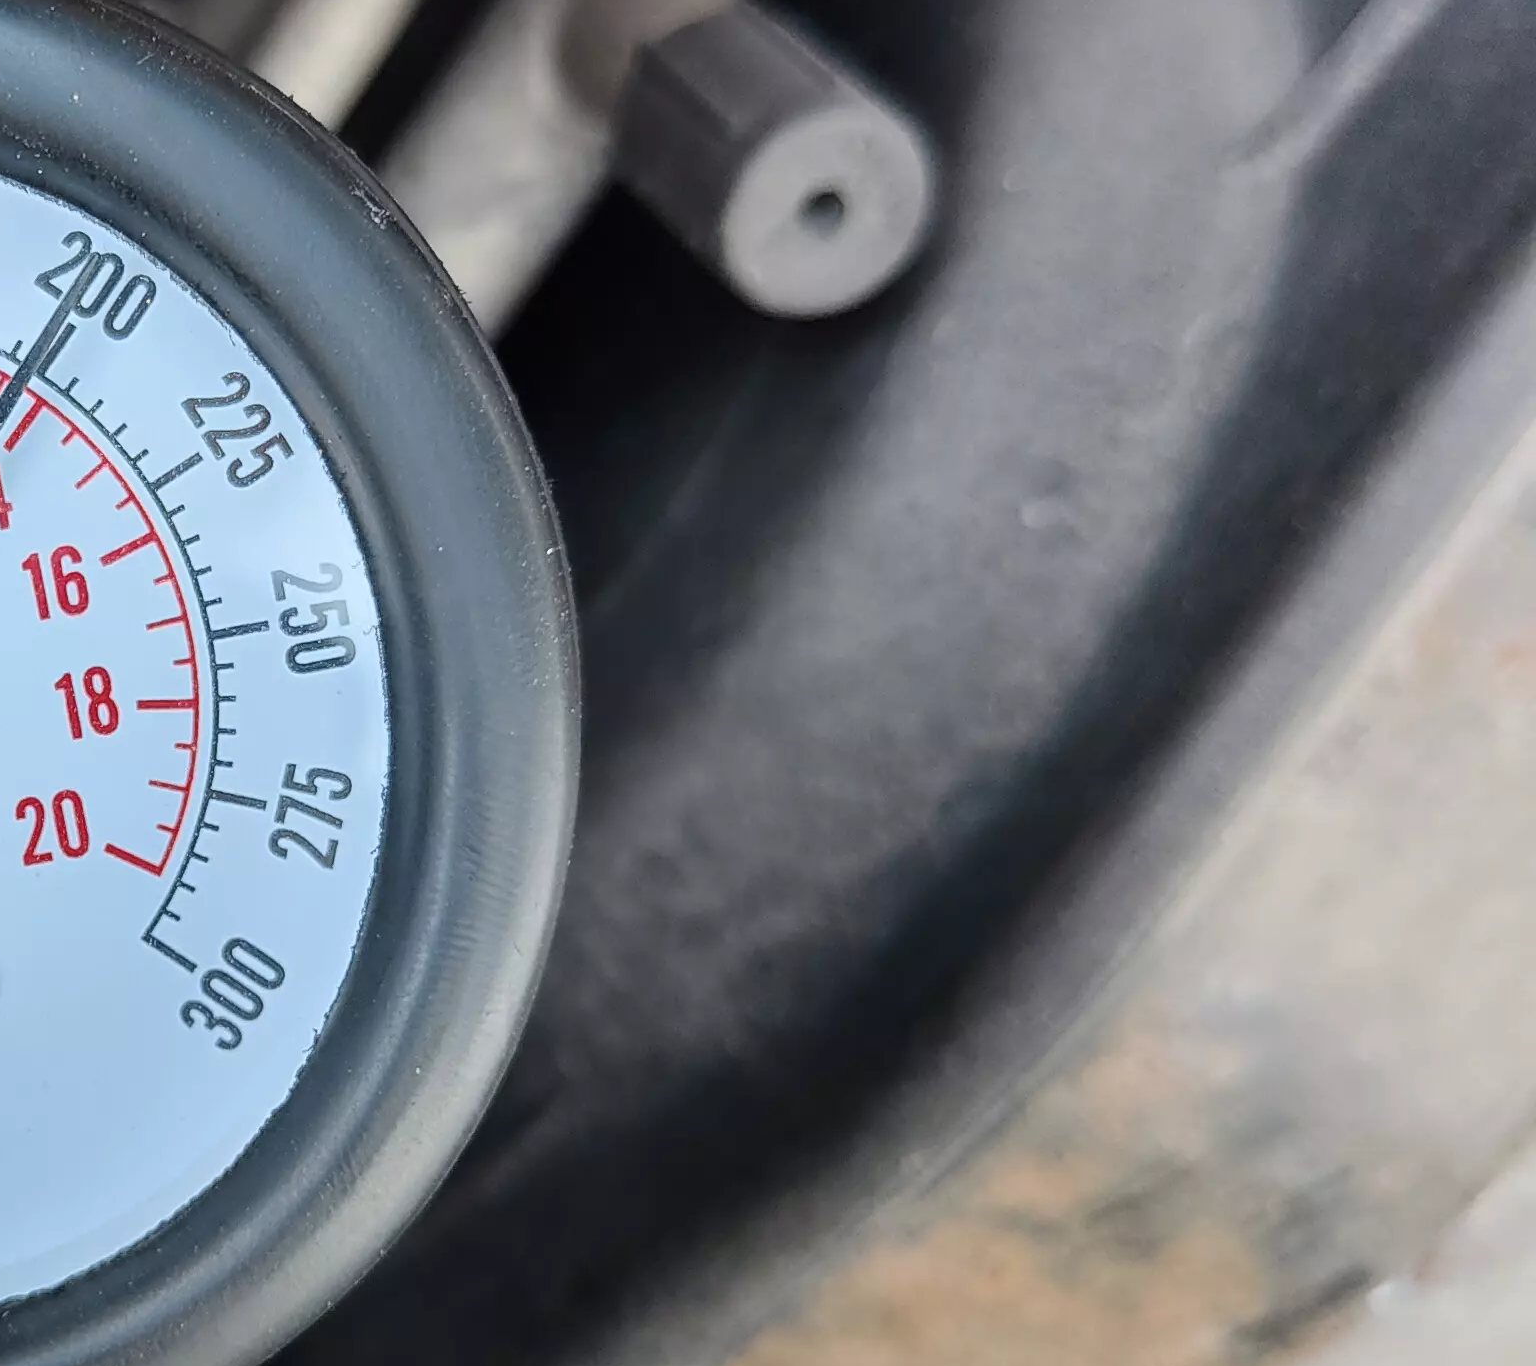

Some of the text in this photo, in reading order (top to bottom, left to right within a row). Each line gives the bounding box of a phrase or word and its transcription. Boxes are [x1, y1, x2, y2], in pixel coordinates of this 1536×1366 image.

[34, 229, 156, 343] 200
[180, 371, 294, 487] 225
[20, 547, 91, 620] 16
[271, 562, 357, 675] 250
[54, 667, 119, 740] 18
[15, 789, 91, 868] 20
[269, 762, 352, 869] 275
[180, 936, 286, 1051] 300
